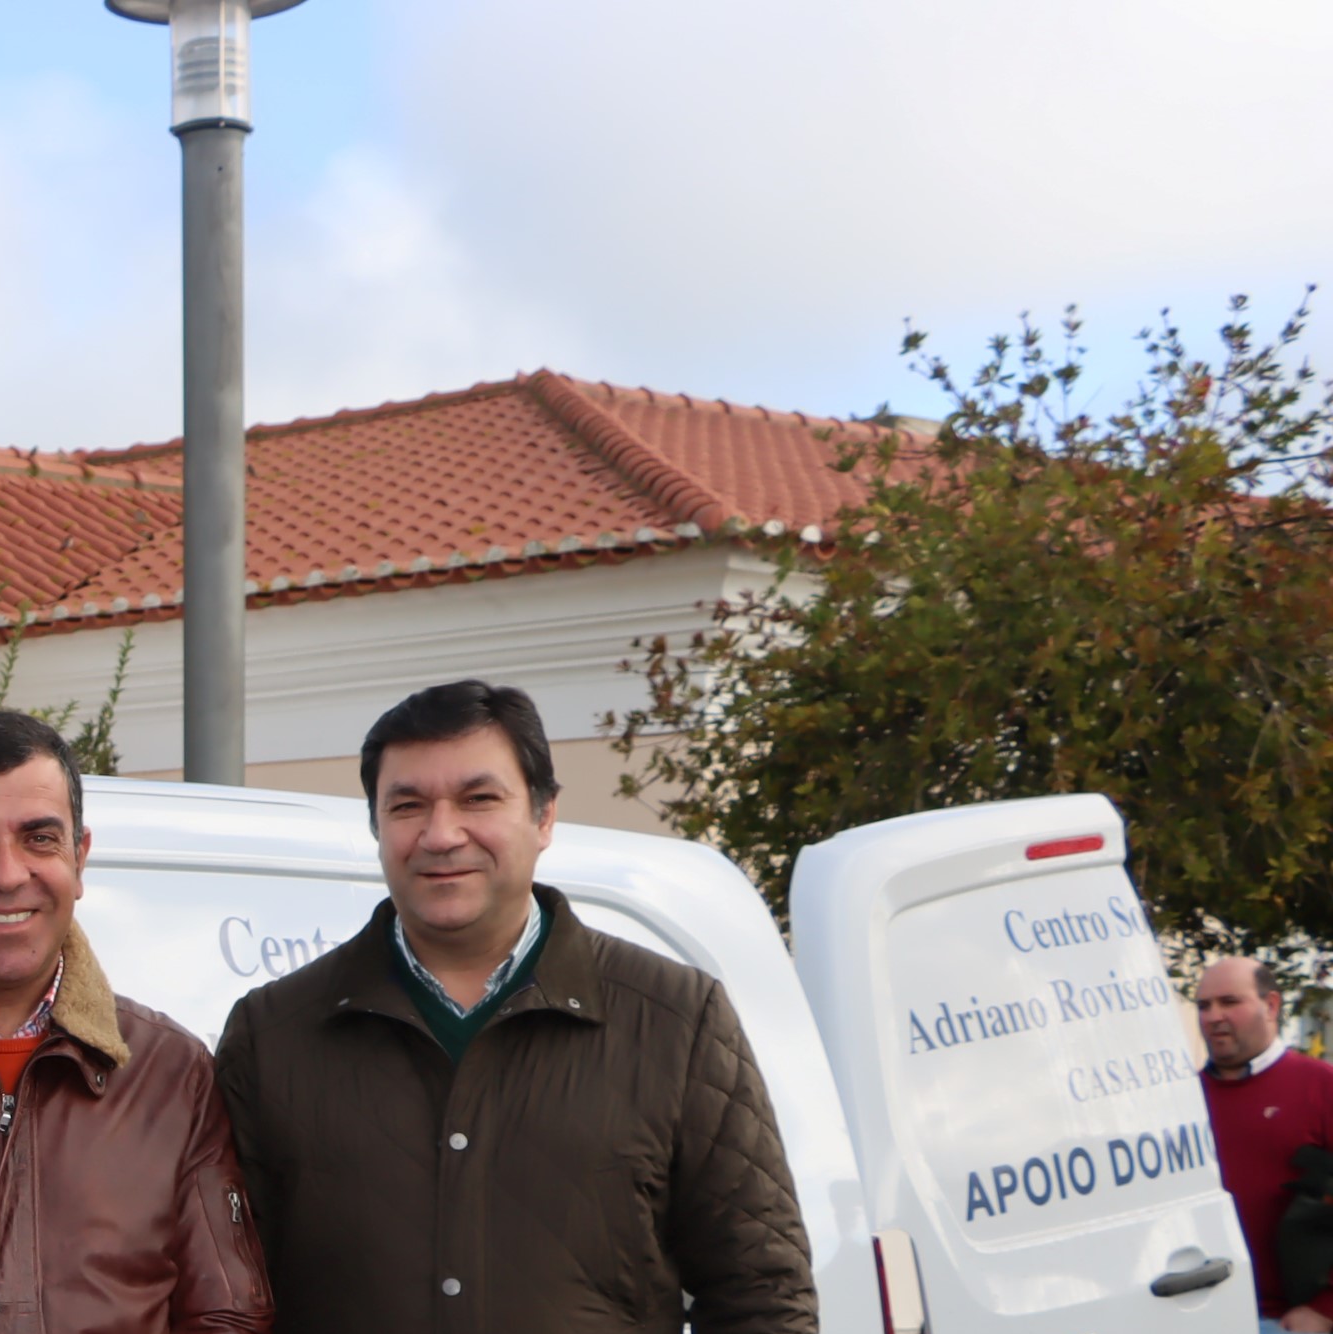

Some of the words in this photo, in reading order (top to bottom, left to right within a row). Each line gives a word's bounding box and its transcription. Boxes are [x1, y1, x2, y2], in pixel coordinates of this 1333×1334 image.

[219, 916, 344, 978] Cent
[1004, 907, 1110, 953] Centro
[909, 995, 1048, 1054] Adriano
[1047, 970, 1170, 1024] Rovisco
[1067, 1058, 1141, 1102] CASA
[966, 1146, 1096, 1222] APOIO
